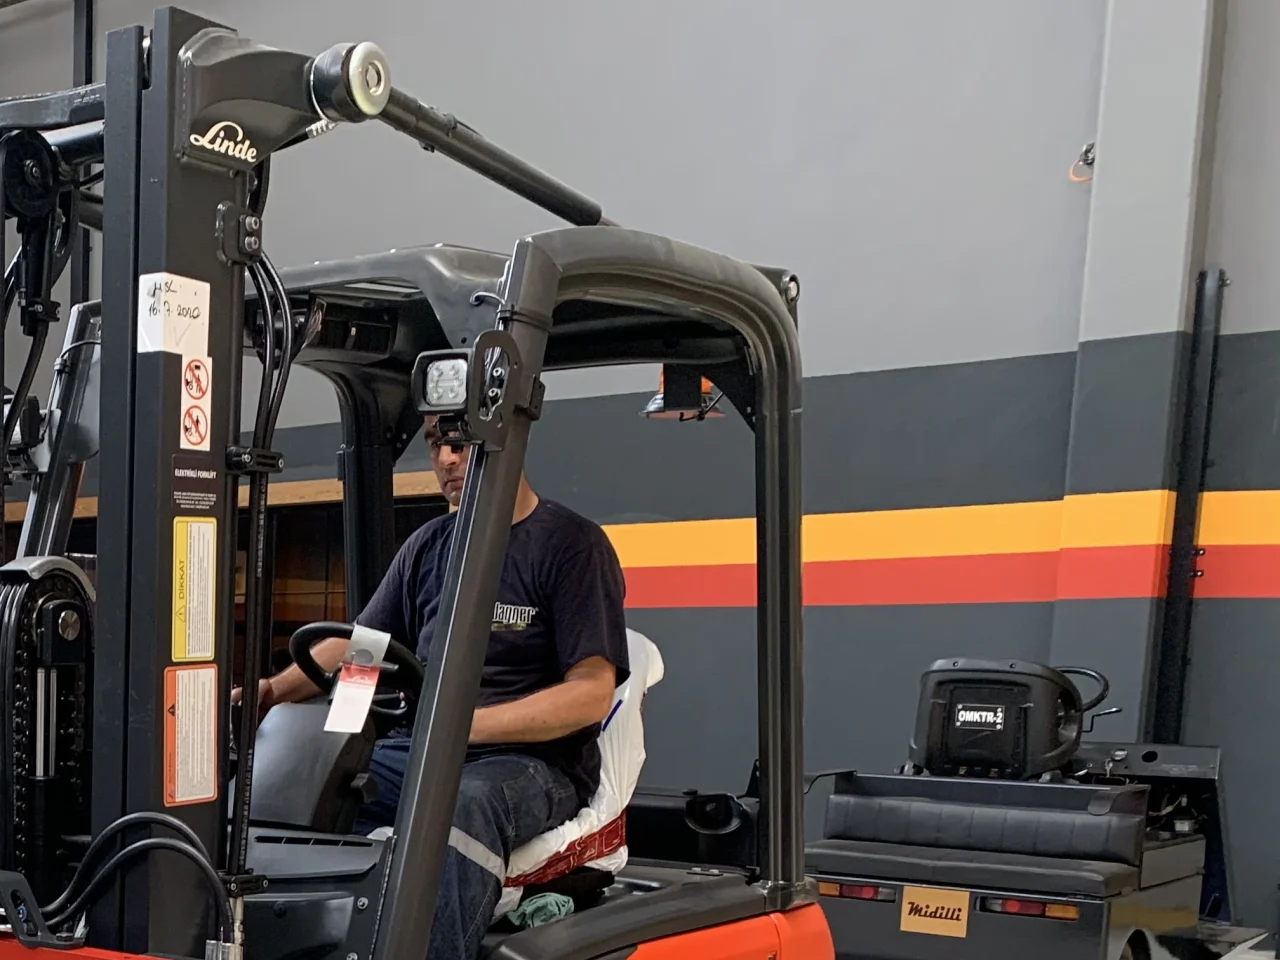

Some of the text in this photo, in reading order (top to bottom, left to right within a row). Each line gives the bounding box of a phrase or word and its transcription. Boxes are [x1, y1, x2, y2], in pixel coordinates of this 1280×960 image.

[189, 121, 257, 162] Linde
[958, 710, 1003, 723] OMKTR-2
[907, 901, 962, 921] Midilli
